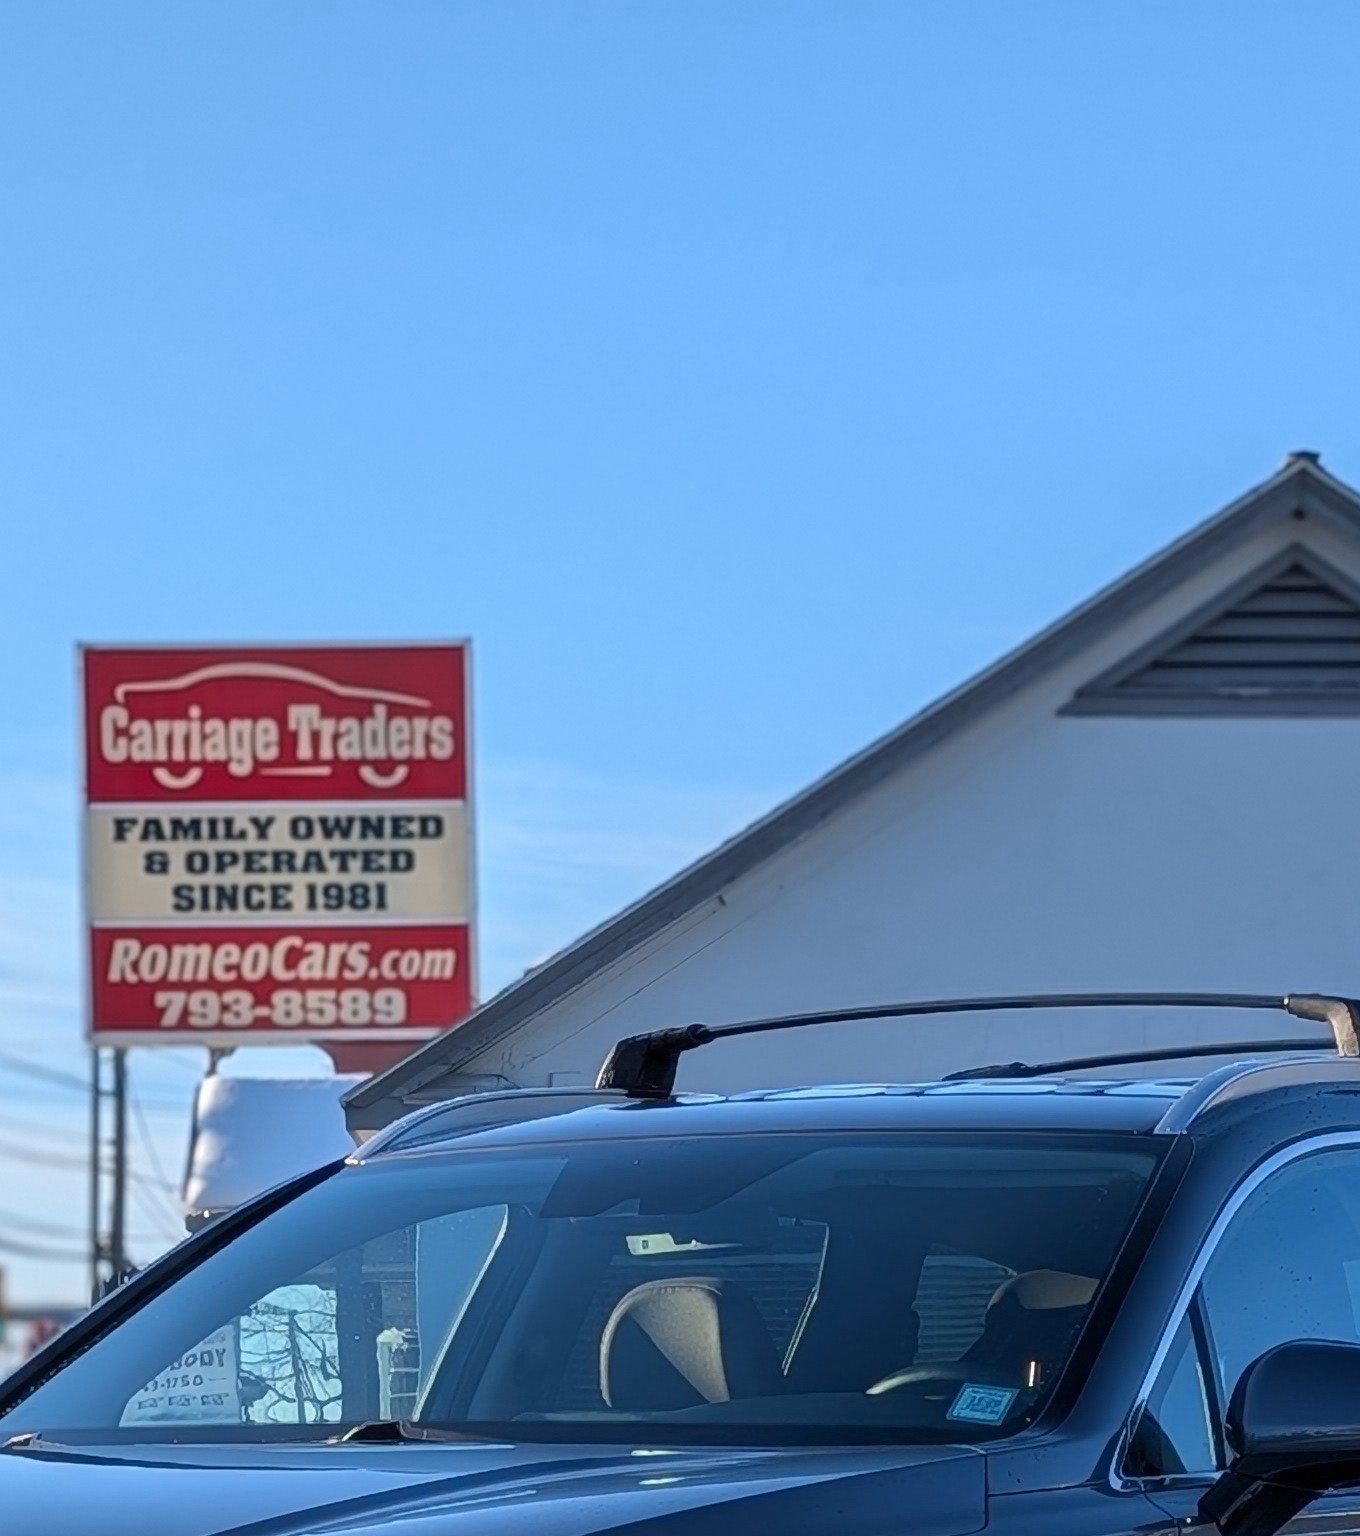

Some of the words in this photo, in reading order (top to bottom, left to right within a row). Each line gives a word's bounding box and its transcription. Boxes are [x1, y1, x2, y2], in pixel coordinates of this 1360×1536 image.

[99, 704, 280, 777] Carriage
[288, 703, 455, 762] Traders
[113, 816, 276, 842] FAMILY
[289, 815, 444, 841] OWNED
[143, 851, 169, 875] &
[185, 849, 415, 874] OPERATED
[172, 884, 293, 912] SINCE
[306, 882, 388, 911] 1981
[108, 936, 456, 983] RomeoCars.com
[153, 988, 407, 1027] 793-8589
